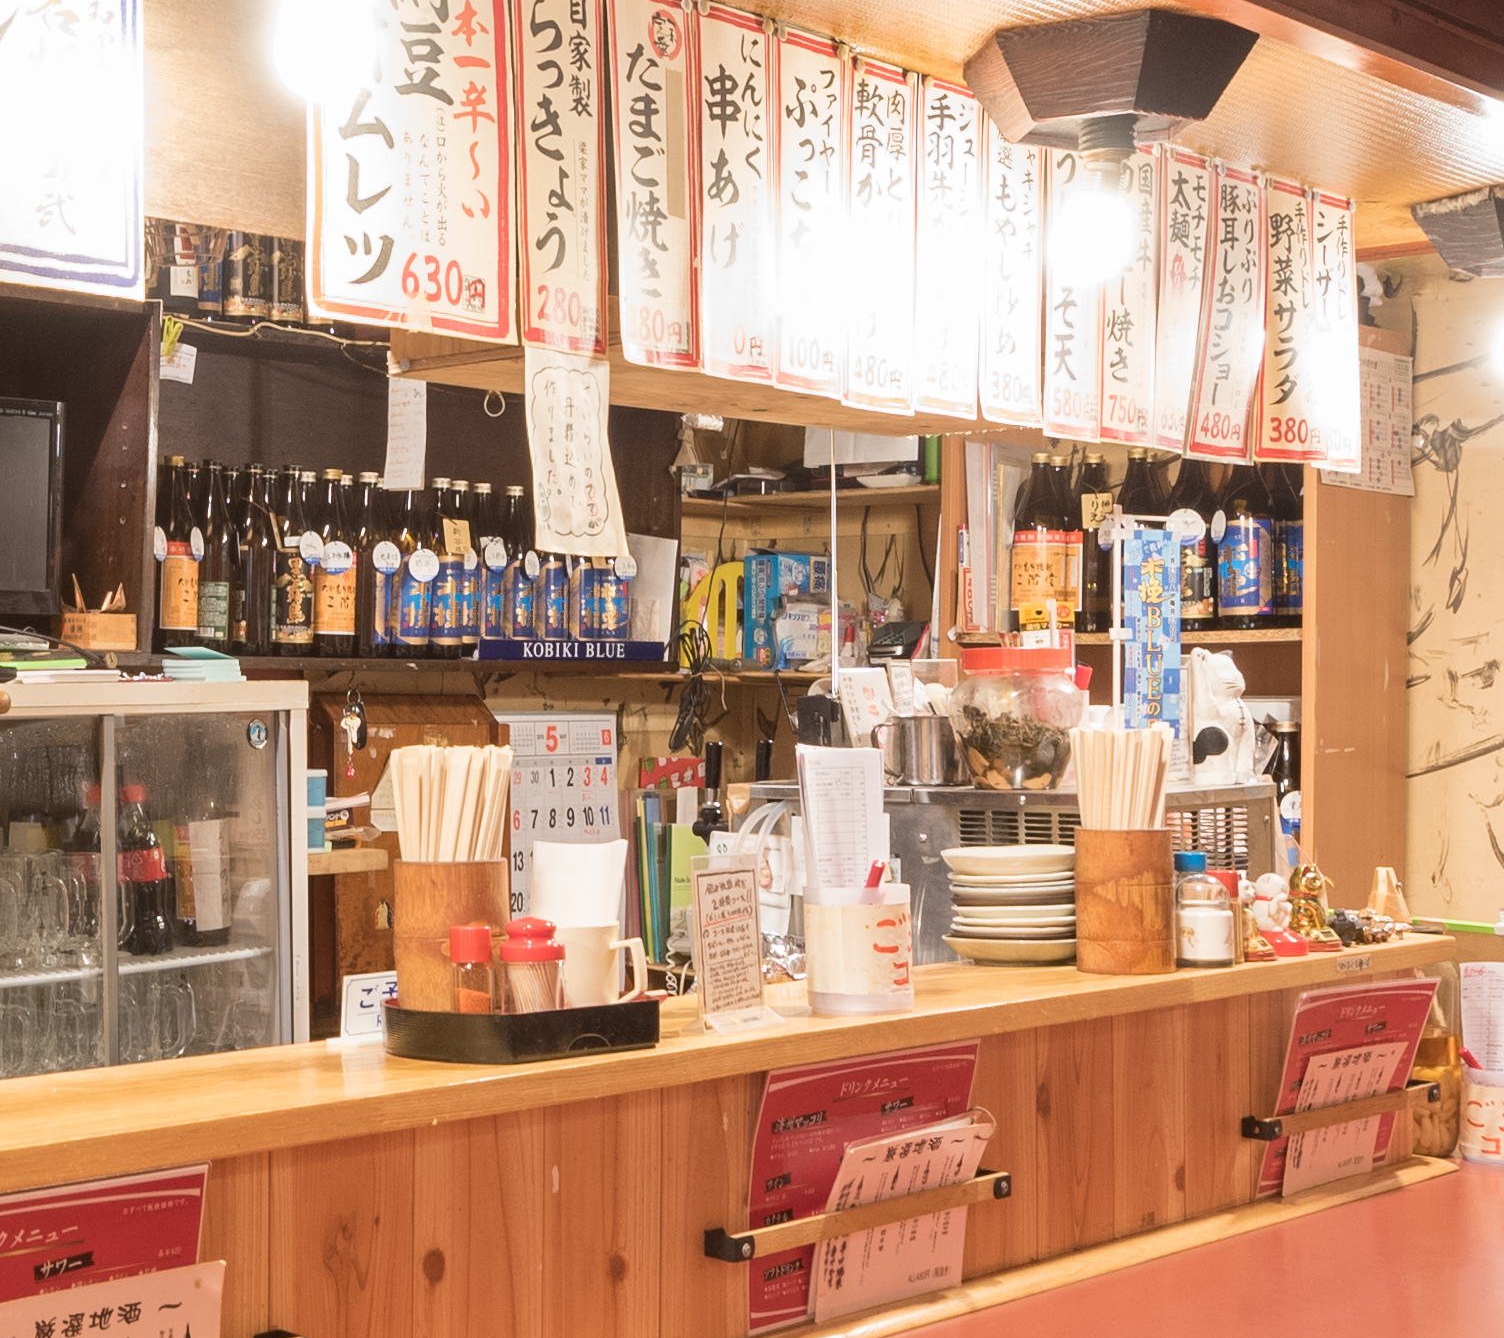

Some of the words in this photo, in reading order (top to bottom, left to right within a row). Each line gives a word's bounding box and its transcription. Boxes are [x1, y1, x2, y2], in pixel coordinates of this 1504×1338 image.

[741, 33, 763, 179] にんにく
[624, 43, 670, 298] たまご焼き
[704, 64, 741, 268] 串あげ
[1136, 163, 1152, 274] 国産牛
[1170, 171, 1191, 248] 太麺
[1189, 174, 1206, 291] モチモチ
[1242, 188, 1257, 304] ぷりぷり
[1211, 184, 1242, 407] 豚耳しおコショー
[1269, 212, 1299, 405] 野菜サラダ
[1201, 411, 1241, 441] 480円
[523, 643, 578, 658] KOBIKI
[585, 643, 625, 658] BLUE
[545, 725, 558, 752] 5
[513, 772, 521, 784] 29
[531, 771, 539, 784] 30
[549, 768, 556, 787] 1
[566, 767, 574, 786] 2
[583, 767, 591, 787] 3
[600, 767, 608, 785] 4
[513, 810, 521, 830] 6
[530, 810, 538, 829] 7
[549, 808, 557, 828] 8
[566, 807, 575, 827] 9
[583, 806, 594, 826] 10
[599, 806, 610, 825] 11
[513, 851, 524, 871] 13
[511, 892, 523, 912] 20
[841, 1077, 909, 1097] ドリンクメニュー
[40, 1257, 83, 1278] サワー
